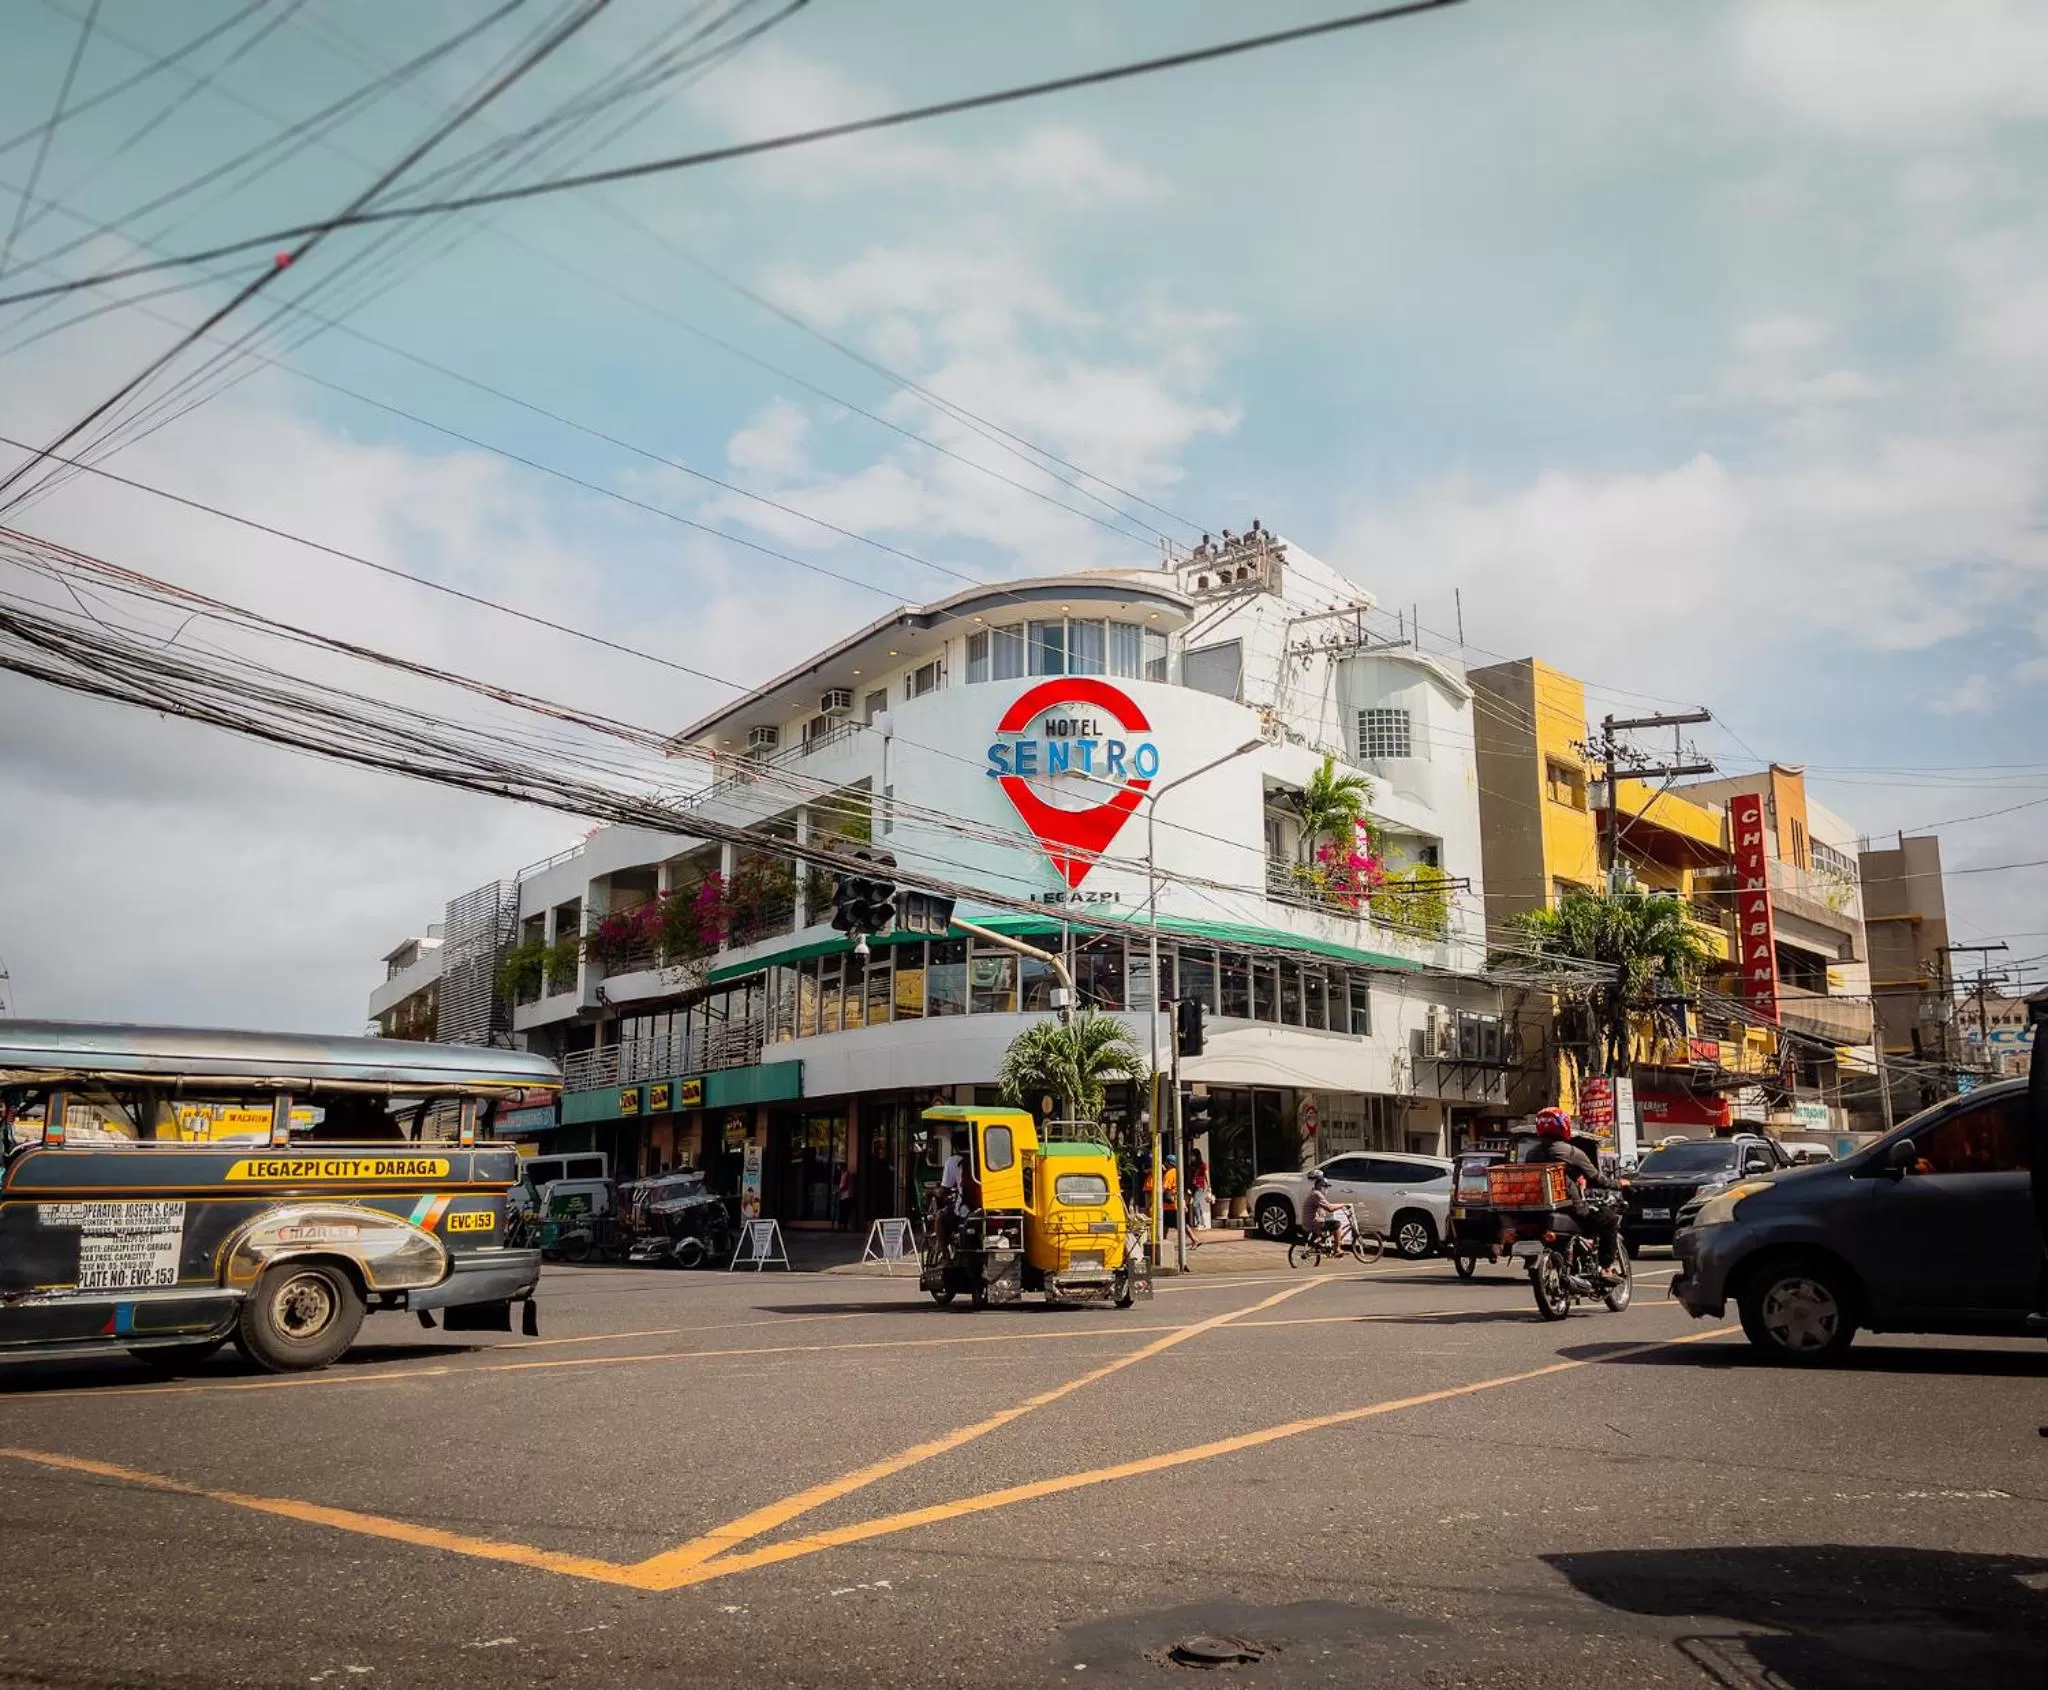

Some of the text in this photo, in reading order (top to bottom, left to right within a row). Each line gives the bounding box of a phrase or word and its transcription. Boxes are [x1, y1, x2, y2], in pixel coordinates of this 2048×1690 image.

[1045, 719, 1103, 737] HOTEL
[986, 739, 1160, 779] SENTRO
[1030, 891, 1120, 904] LEGAZPI
[1740, 808, 1773, 1005] CHINABANK
[247, 1160, 437, 1178] LEGAZPI CITY DARAGA
[125, 1203, 154, 1218] JOSEPH
[450, 1213, 491, 1229] EVC-153
[78, 1268, 174, 1287] PLATE NO: EVC-153
